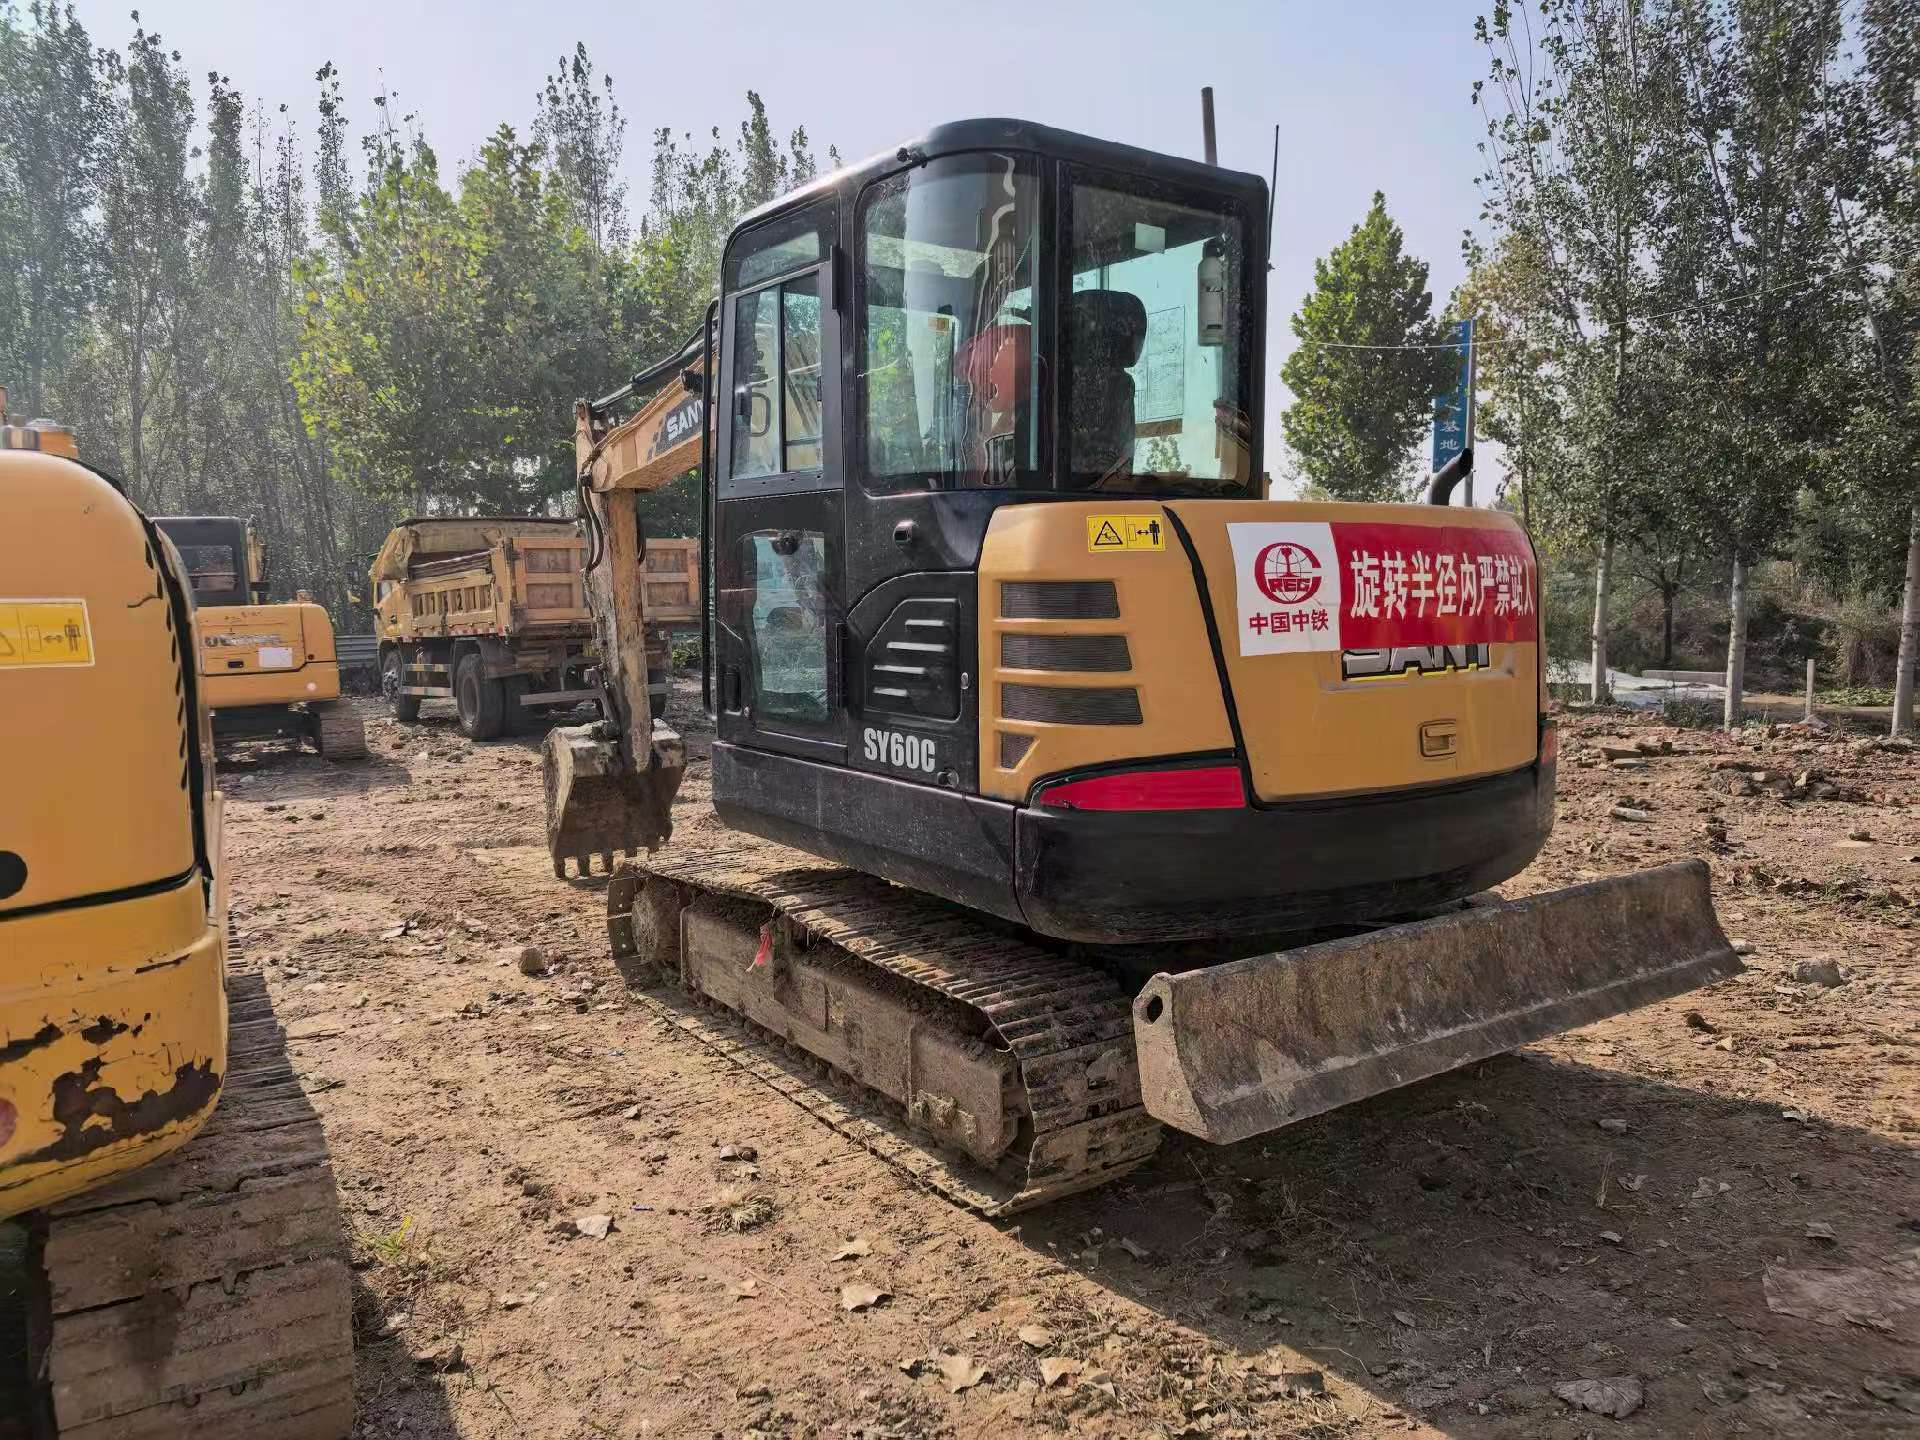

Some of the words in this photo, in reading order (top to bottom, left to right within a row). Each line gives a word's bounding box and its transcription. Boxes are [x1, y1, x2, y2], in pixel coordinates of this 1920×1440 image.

[1350, 550, 1535, 618] 旋转半径内严禁站人
[1249, 608, 1329, 636] 中国中铁
[863, 727, 936, 773] SY60C
